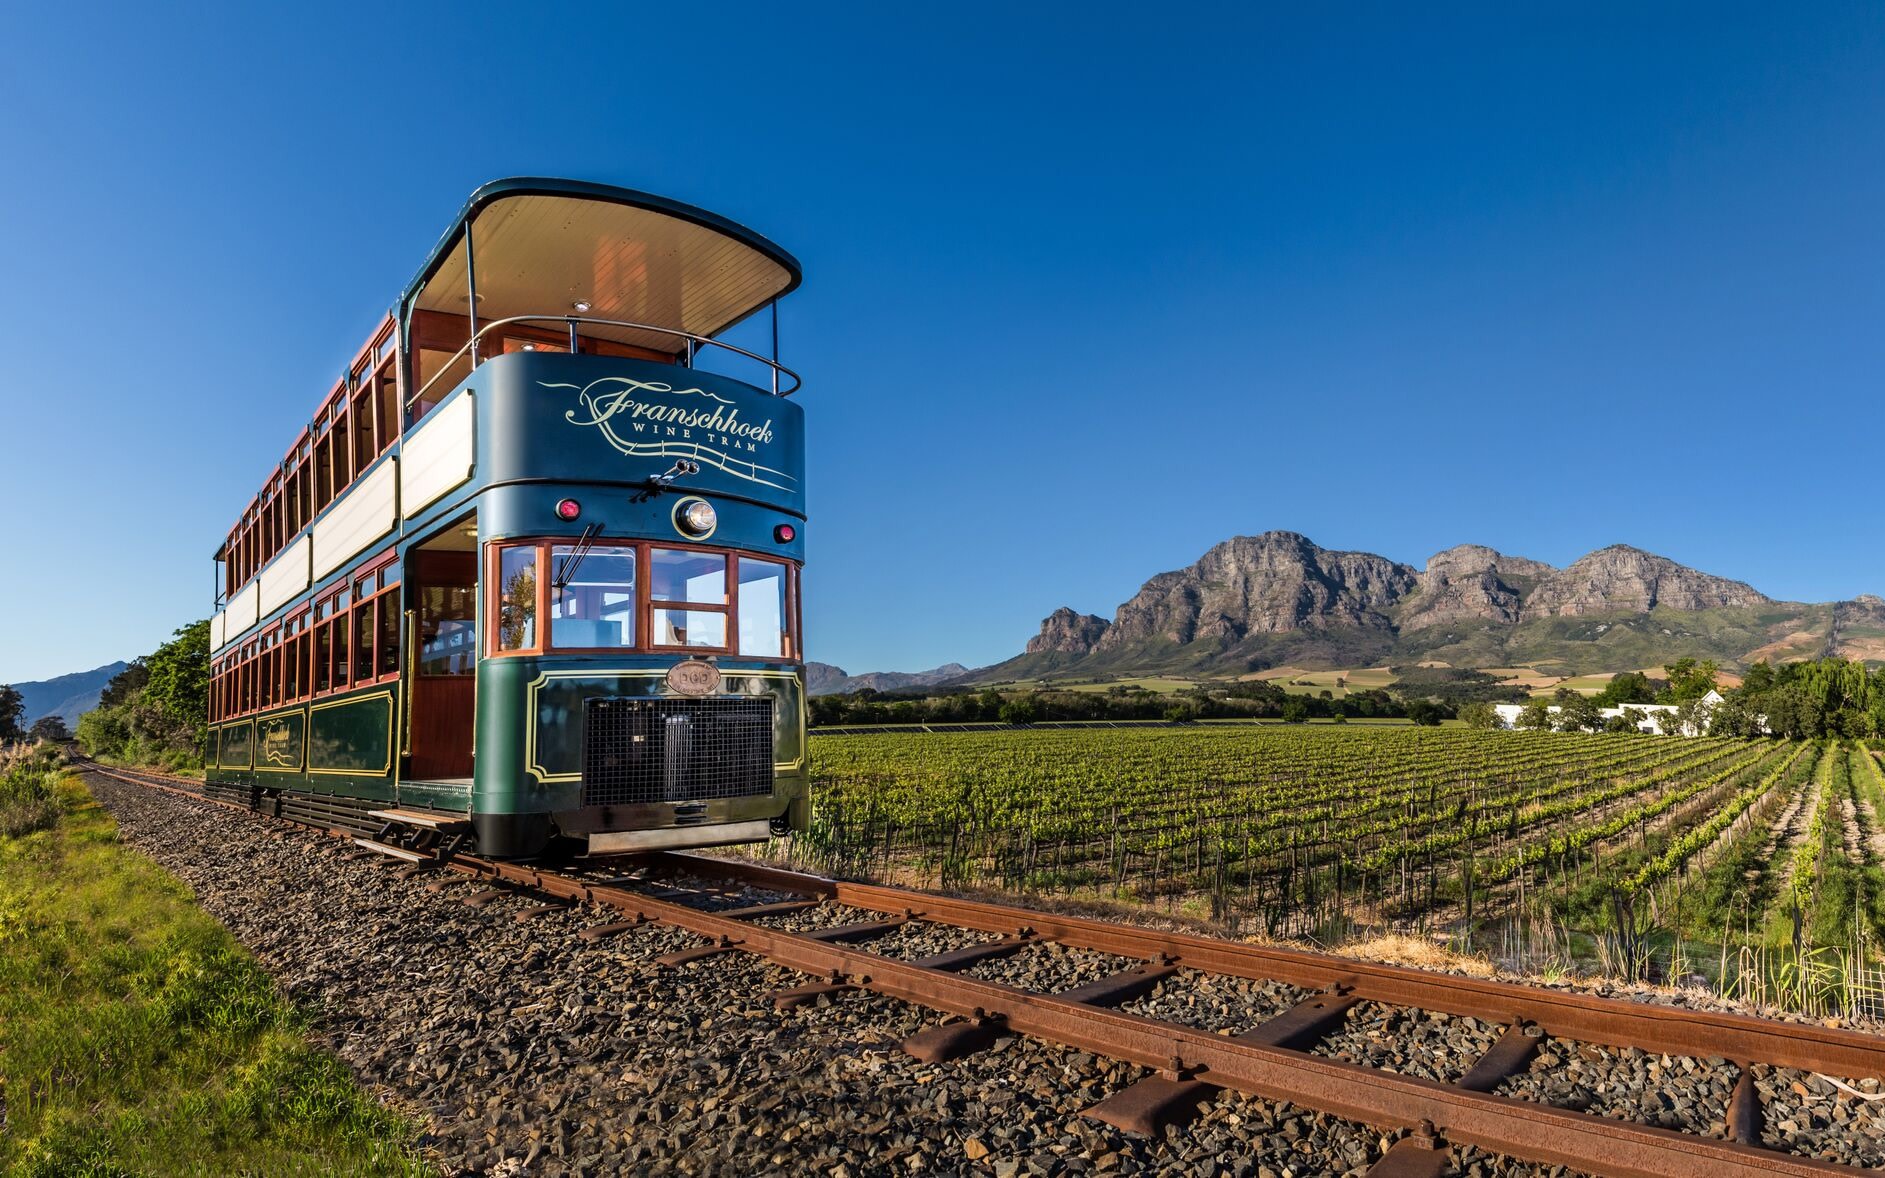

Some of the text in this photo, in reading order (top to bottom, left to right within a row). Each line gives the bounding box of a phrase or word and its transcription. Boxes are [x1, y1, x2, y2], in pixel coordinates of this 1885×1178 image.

[565, 377, 773, 444] Franschhoek
[632, 422, 756, 453] WINE TRAM
